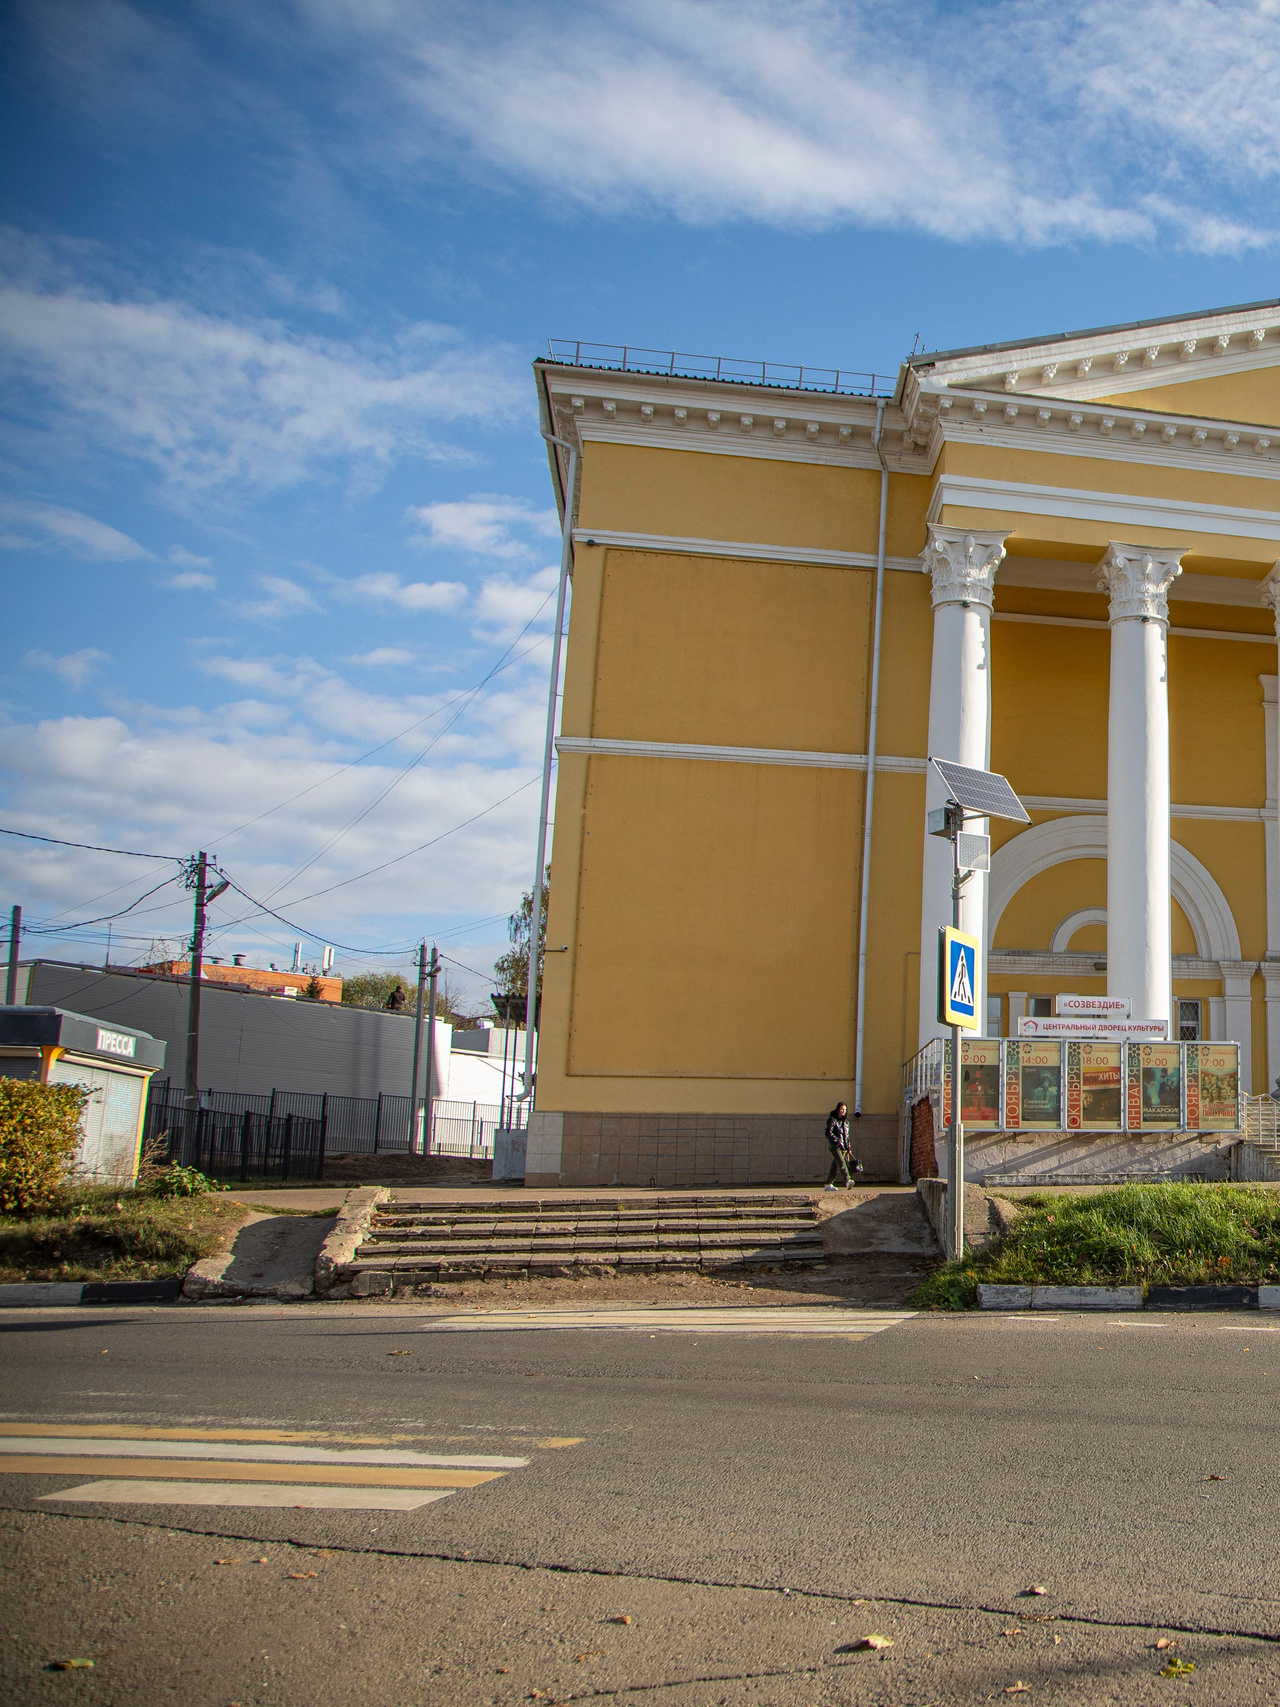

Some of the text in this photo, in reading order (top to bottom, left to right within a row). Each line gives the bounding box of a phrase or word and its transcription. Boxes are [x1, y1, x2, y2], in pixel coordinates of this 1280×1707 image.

[1063, 1000, 1125, 1010] «СОЗВЕЗДИЕ»
[1043, 1023, 1097, 1031] ЦЕНТРАЛЬНЫЙ
[1098, 1024, 1127, 1032] ДВОРЕЦ
[98, 1030, 135, 1057] ПРЕССА
[961, 1055, 986, 1063] 9:00
[1008, 1055, 1017, 1064] 17
[1021, 1056, 1048, 1064] 14:00
[1069, 1056, 1079, 1065] 19
[1082, 1057, 1109, 1065] 18:00
[1129, 1057, 1139, 1066] 18
[1142, 1058, 1168, 1066] 19:00
[1187, 1059, 1198, 1067] 24
[1201, 1058, 1225, 1067] 17:00
[1098, 1071, 1120, 1081] ХИТЫ
[1007, 1065, 1019, 1128] НОЯБРЯ
[1068, 1066, 1080, 1127] ОКТЯБРЯ
[1129, 1067, 1140, 1128] ЯНВАРЯ
[1187, 1068, 1199, 1128] НОЯБРЯ
